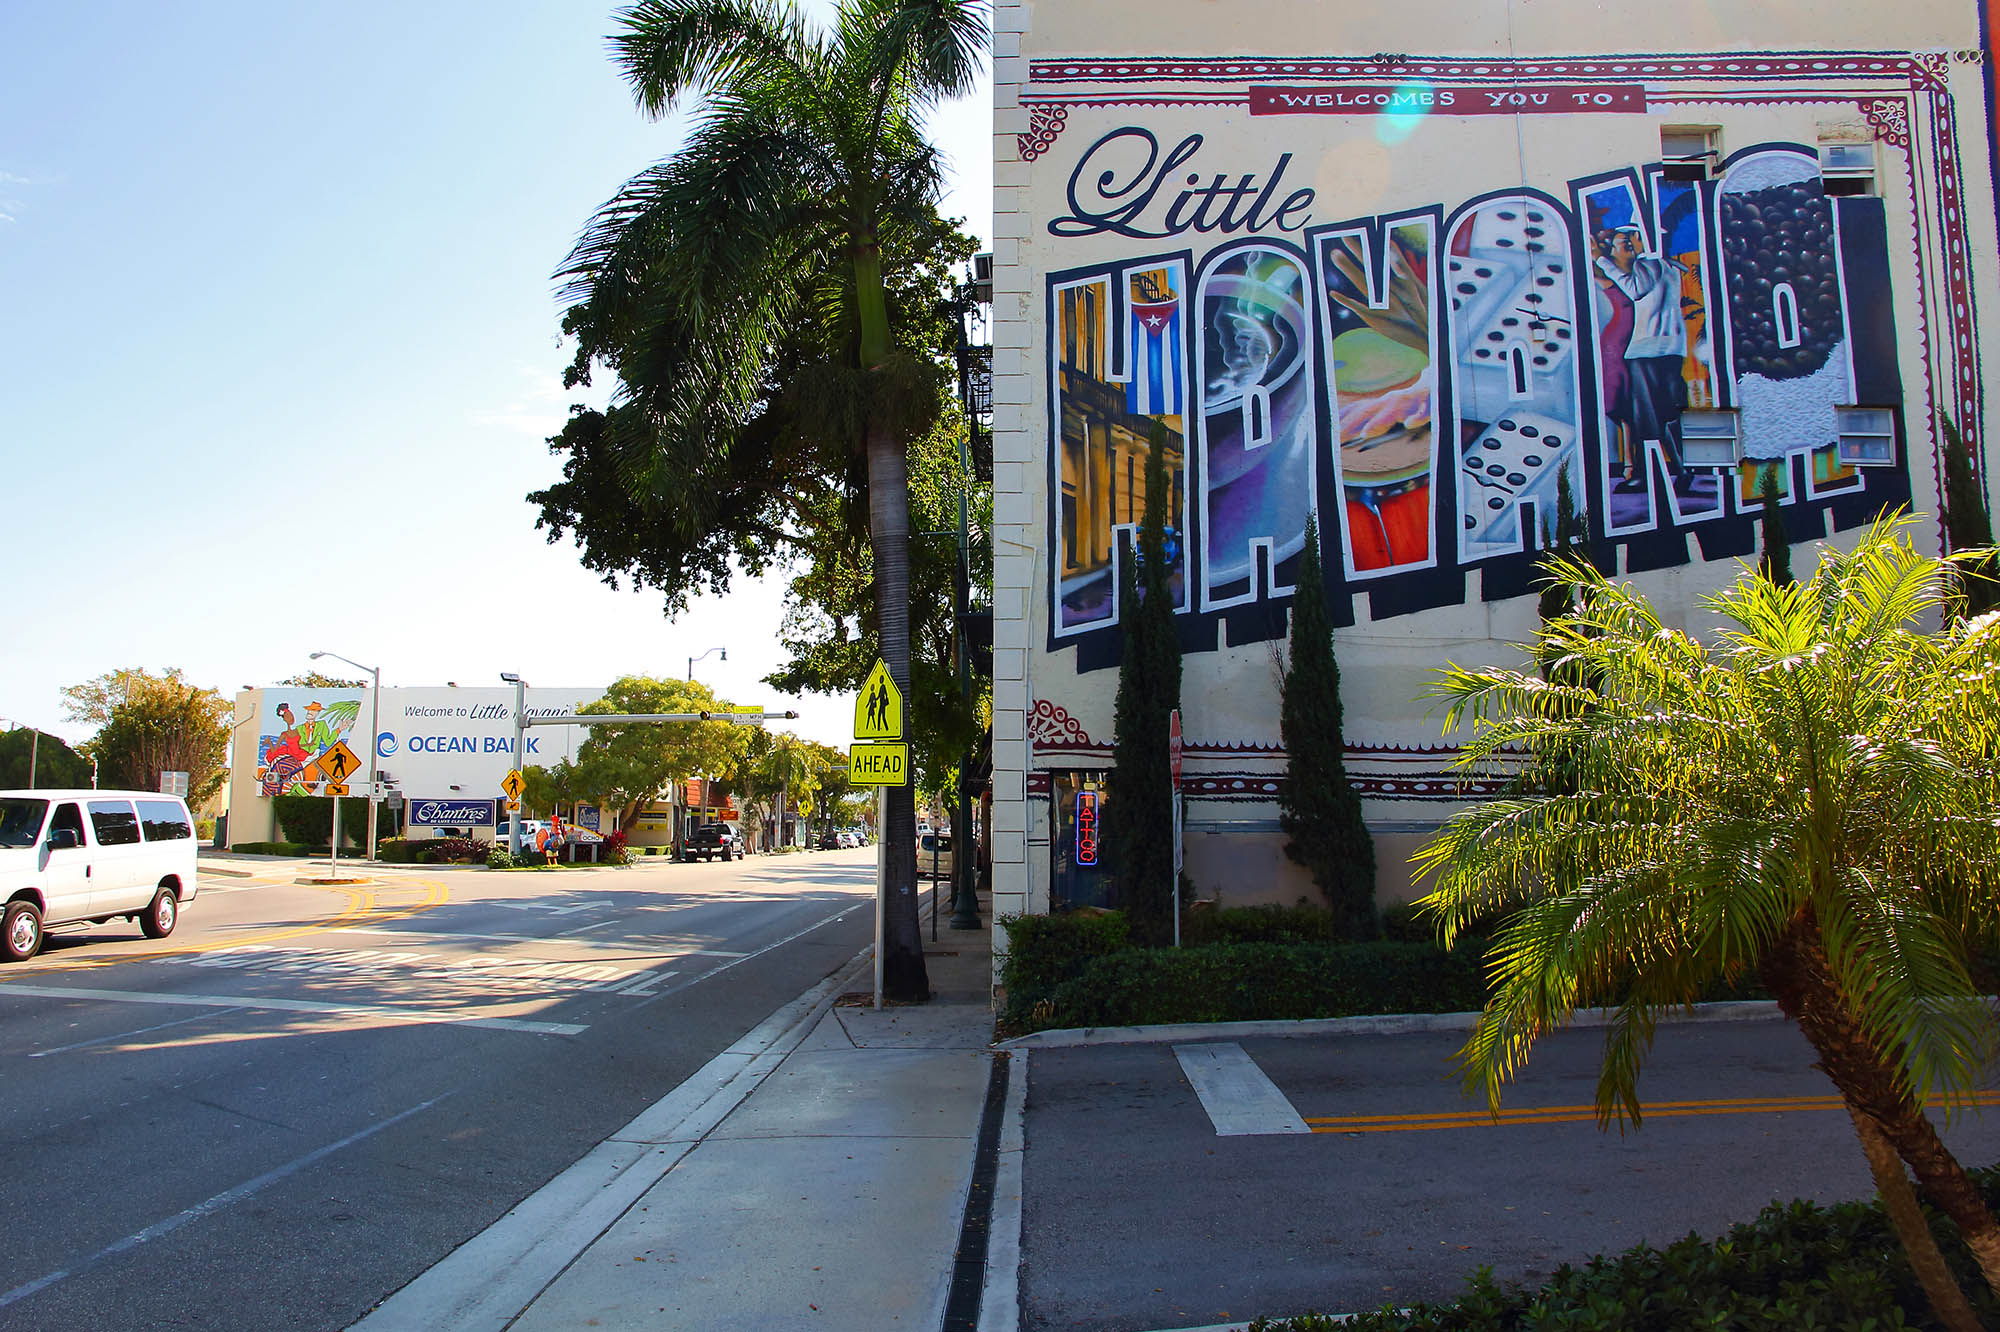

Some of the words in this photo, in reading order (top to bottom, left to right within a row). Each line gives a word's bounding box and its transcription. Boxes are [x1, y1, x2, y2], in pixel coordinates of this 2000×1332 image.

[1279, 91, 1456, 108] WELCOMES
[1484, 91, 1550, 107] YOU
[1571, 92, 1614, 106] TO
[1047, 126, 1316, 240] Little
[1047, 141, 1890, 660] HAVANA
[404, 705, 454, 718] Welcome
[456, 707, 467, 717] to
[470, 703, 509, 720] Little
[408, 736, 477, 754] OCEAN
[854, 755, 902, 773] AHEAD
[416, 802, 488, 824] Chantres
[1080, 795, 1095, 862] TATTOO
